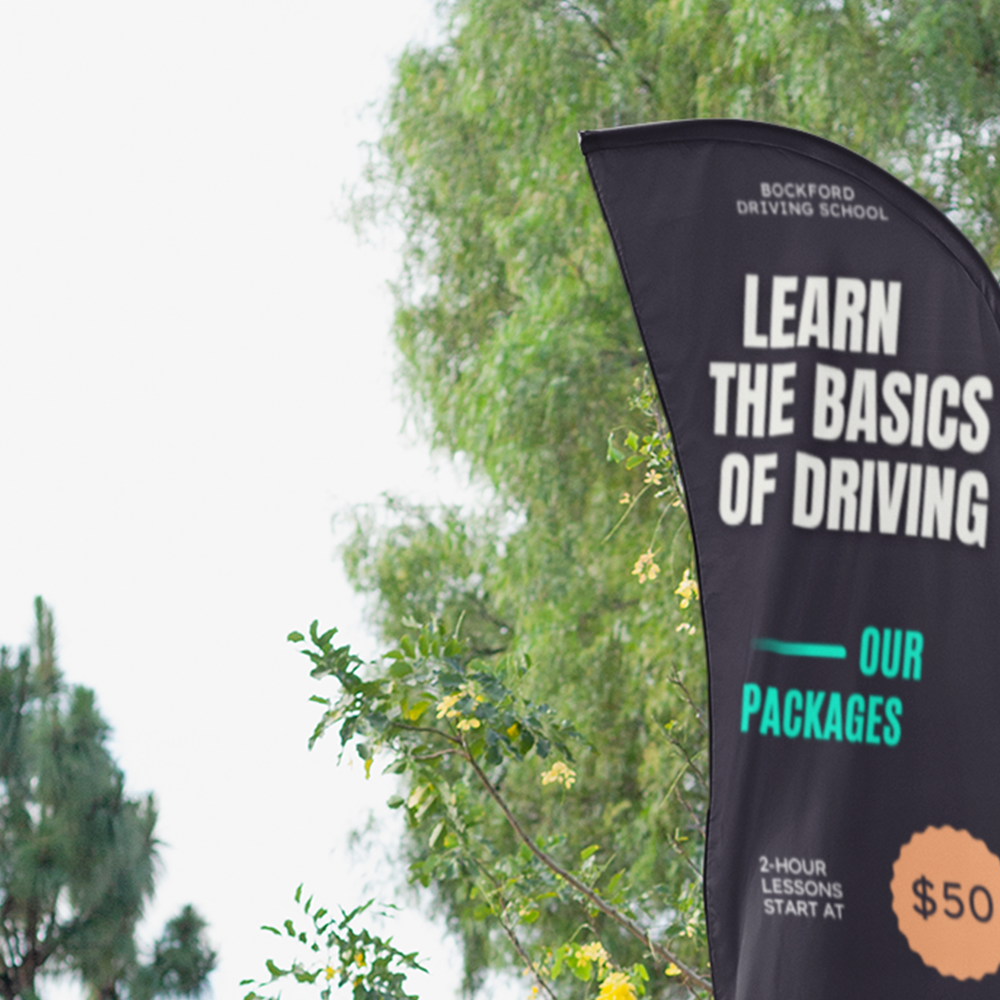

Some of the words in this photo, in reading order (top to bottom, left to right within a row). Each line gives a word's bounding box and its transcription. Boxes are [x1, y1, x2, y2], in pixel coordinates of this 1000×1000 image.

[737, 201, 814, 217] DRIVING
[819, 203, 889, 221] SCHOOL
[760, 182, 855, 201] BOCKFORD
[743, 274, 902, 356] LEARN
[709, 362, 797, 438] THE
[813, 363, 993, 454] BASICS
[718, 452, 778, 526] OF
[792, 451, 989, 549] DRIVING
[859, 626, 924, 681] OUR
[740, 682, 903, 747] PACKAGES
[759, 856, 827, 877] 2-HOUR
[761, 878, 843, 899] LESSONS
[764, 898, 818, 918] START
[823, 903, 845, 920] AT
[912, 875, 994, 923] $50
